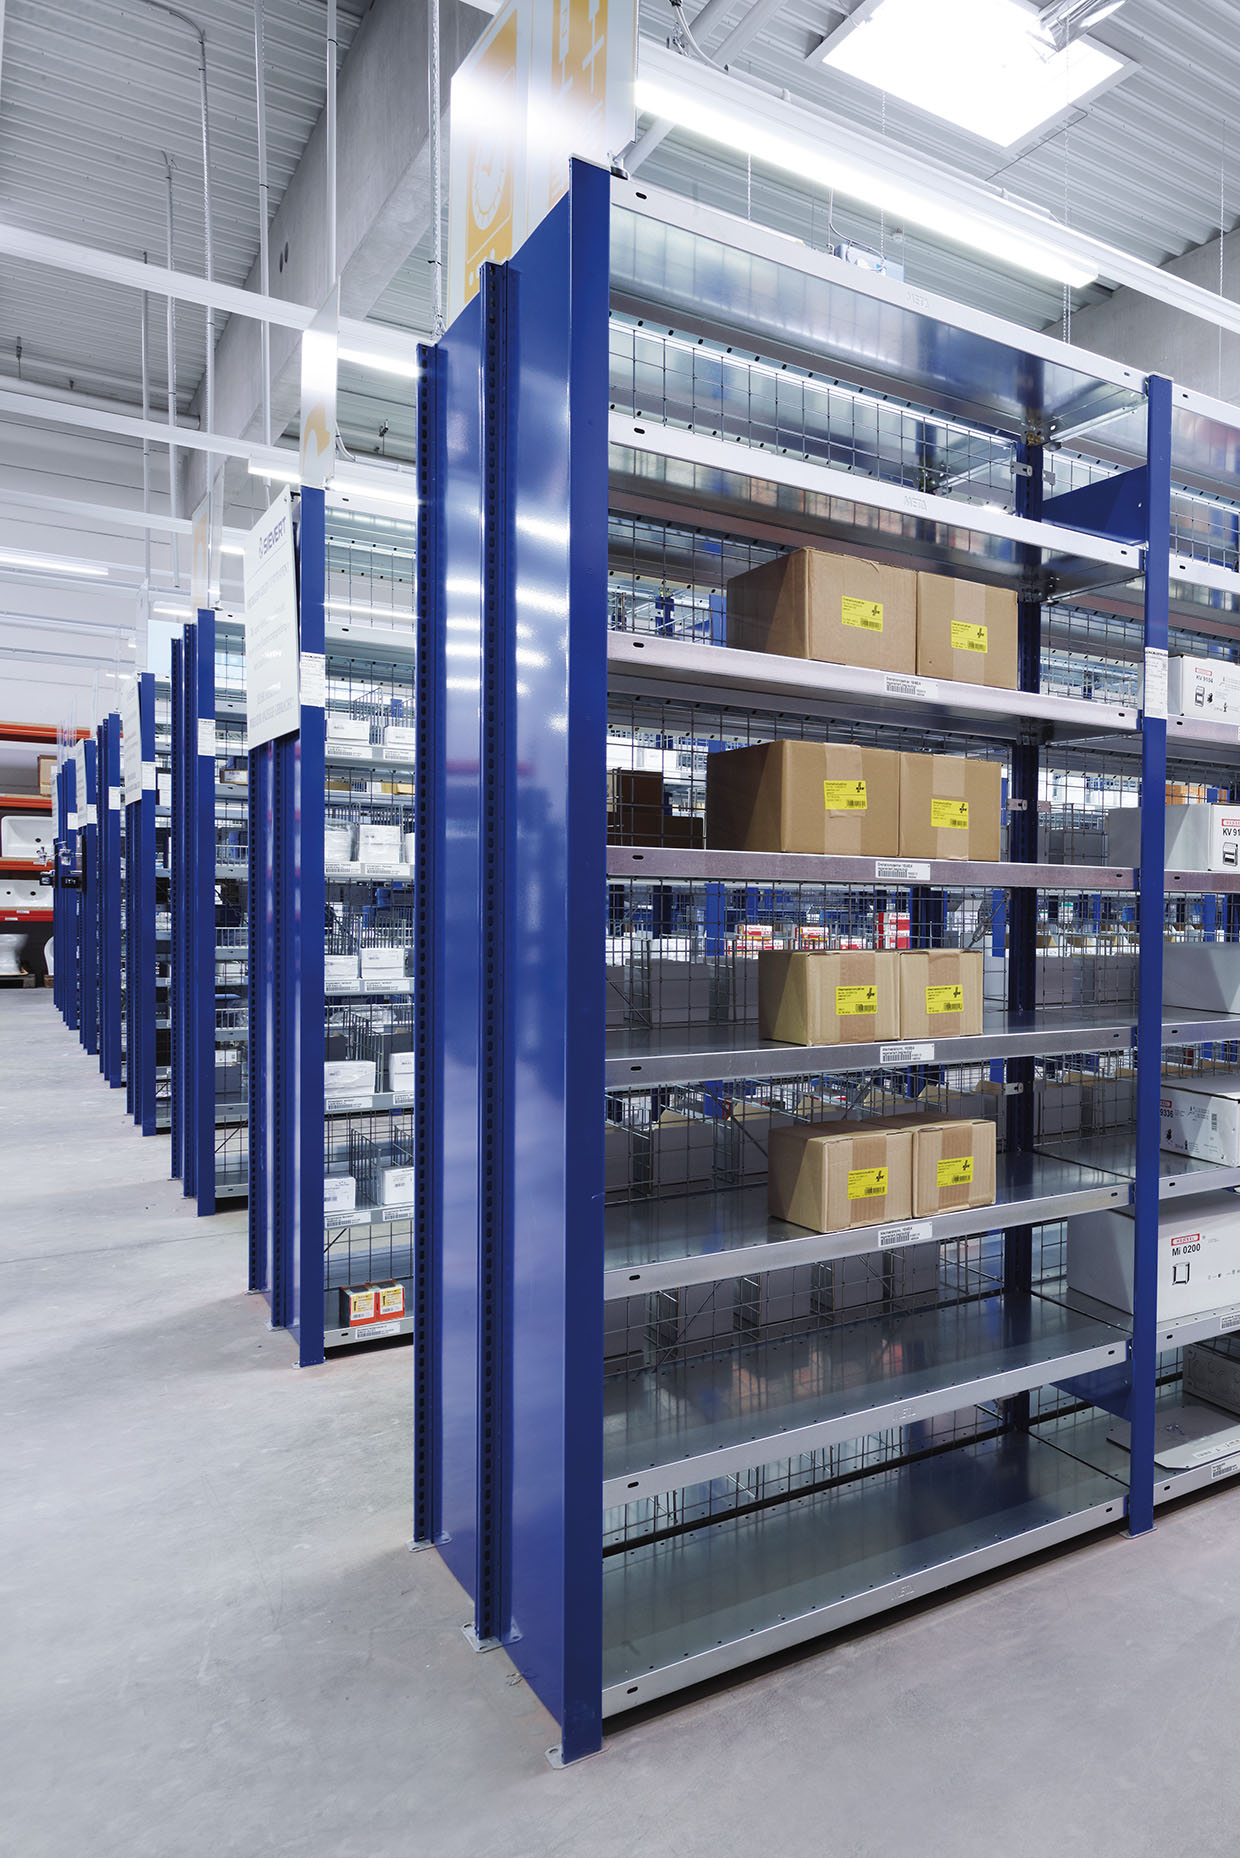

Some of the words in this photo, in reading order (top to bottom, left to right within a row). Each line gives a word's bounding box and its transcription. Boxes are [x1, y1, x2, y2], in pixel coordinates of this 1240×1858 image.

[264, 516, 287, 555] SIEVERT
[1222, 828, 1232, 836] KV
[1172, 1247, 1181, 1256] Mi
[1183, 1243, 1201, 1254] 0200
